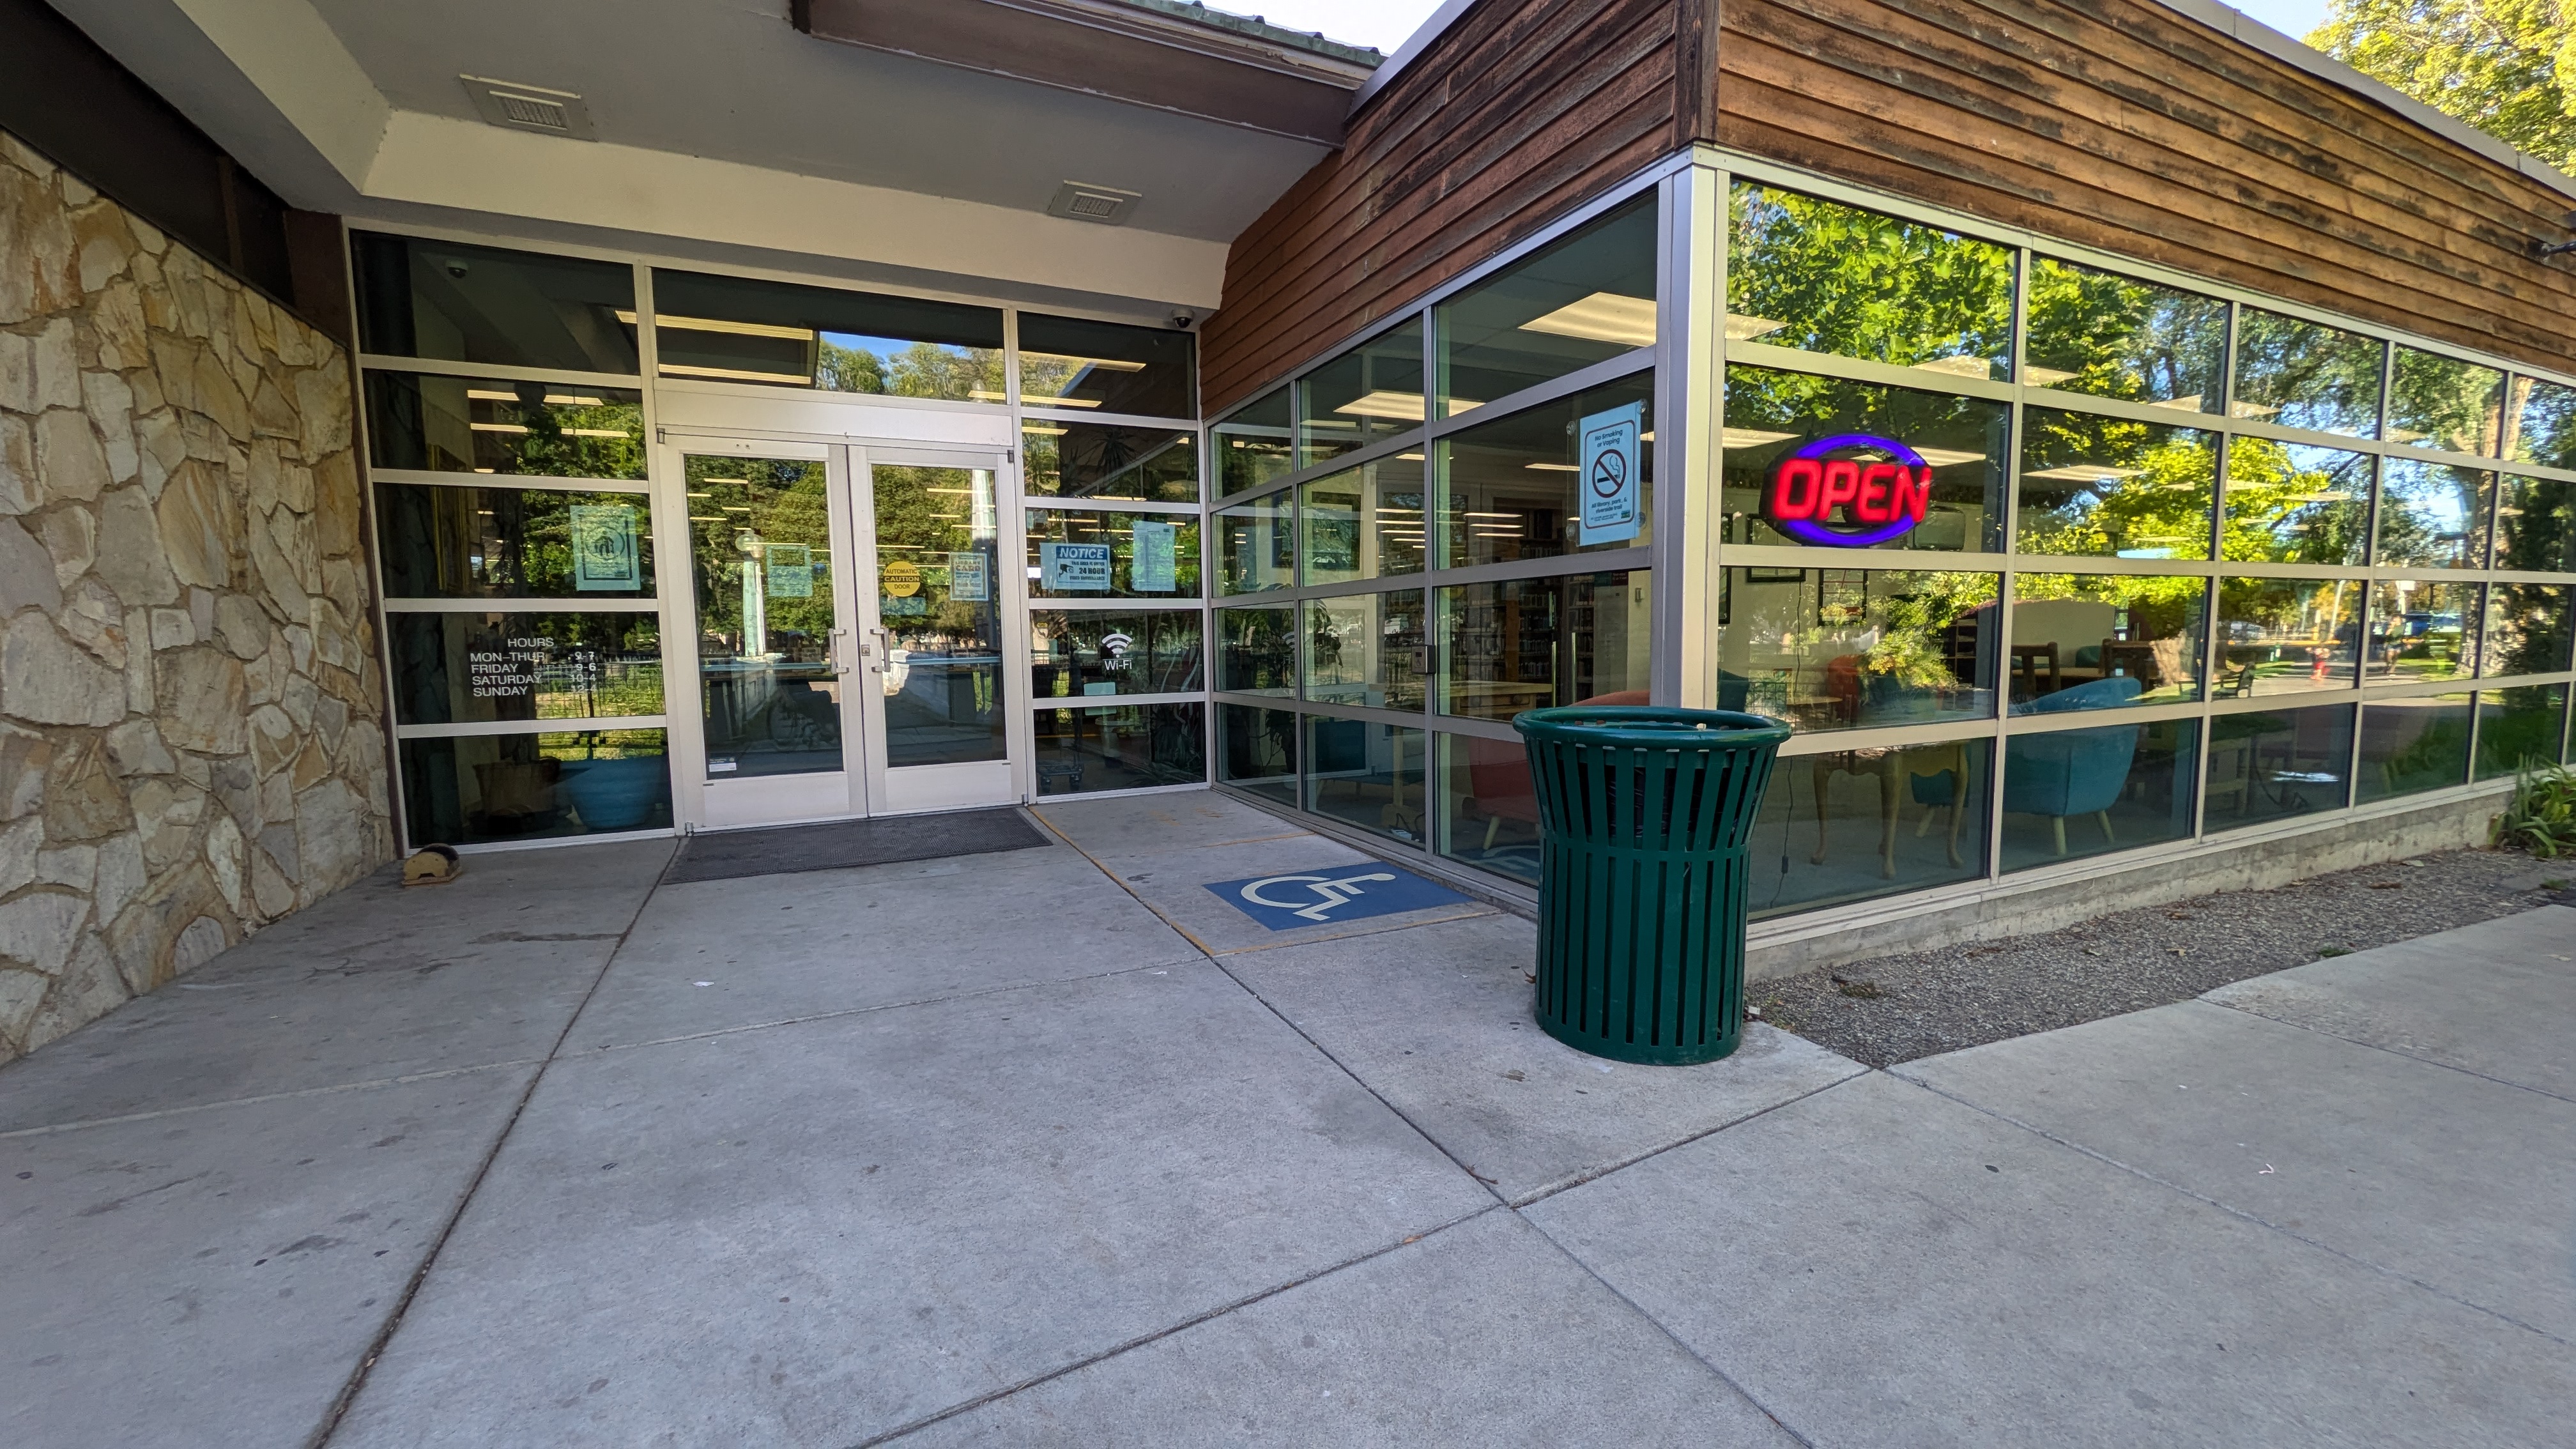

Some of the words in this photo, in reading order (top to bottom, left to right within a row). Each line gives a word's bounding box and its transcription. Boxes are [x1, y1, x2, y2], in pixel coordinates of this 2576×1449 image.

[1602, 429, 1623, 440] Smoking
[1602, 437, 1620, 447] Vaping
[1773, 457, 1933, 523] OPEN
[1059, 547, 1105, 559] NOTICE
[508, 638, 554, 647] HOURS
[470, 652, 545, 663] MON-THUR
[575, 651, 595, 661] 9-7
[471, 664, 519, 674] FRIDAY
[576, 663, 597, 671] 9-6
[1105, 659, 1132, 670] Wi-Fi
[472, 674, 542, 686] SATURDAY
[571, 673, 597, 682] 10-4
[473, 686, 528, 697] SUNDAY
[571, 684, 597, 693] 12-4
